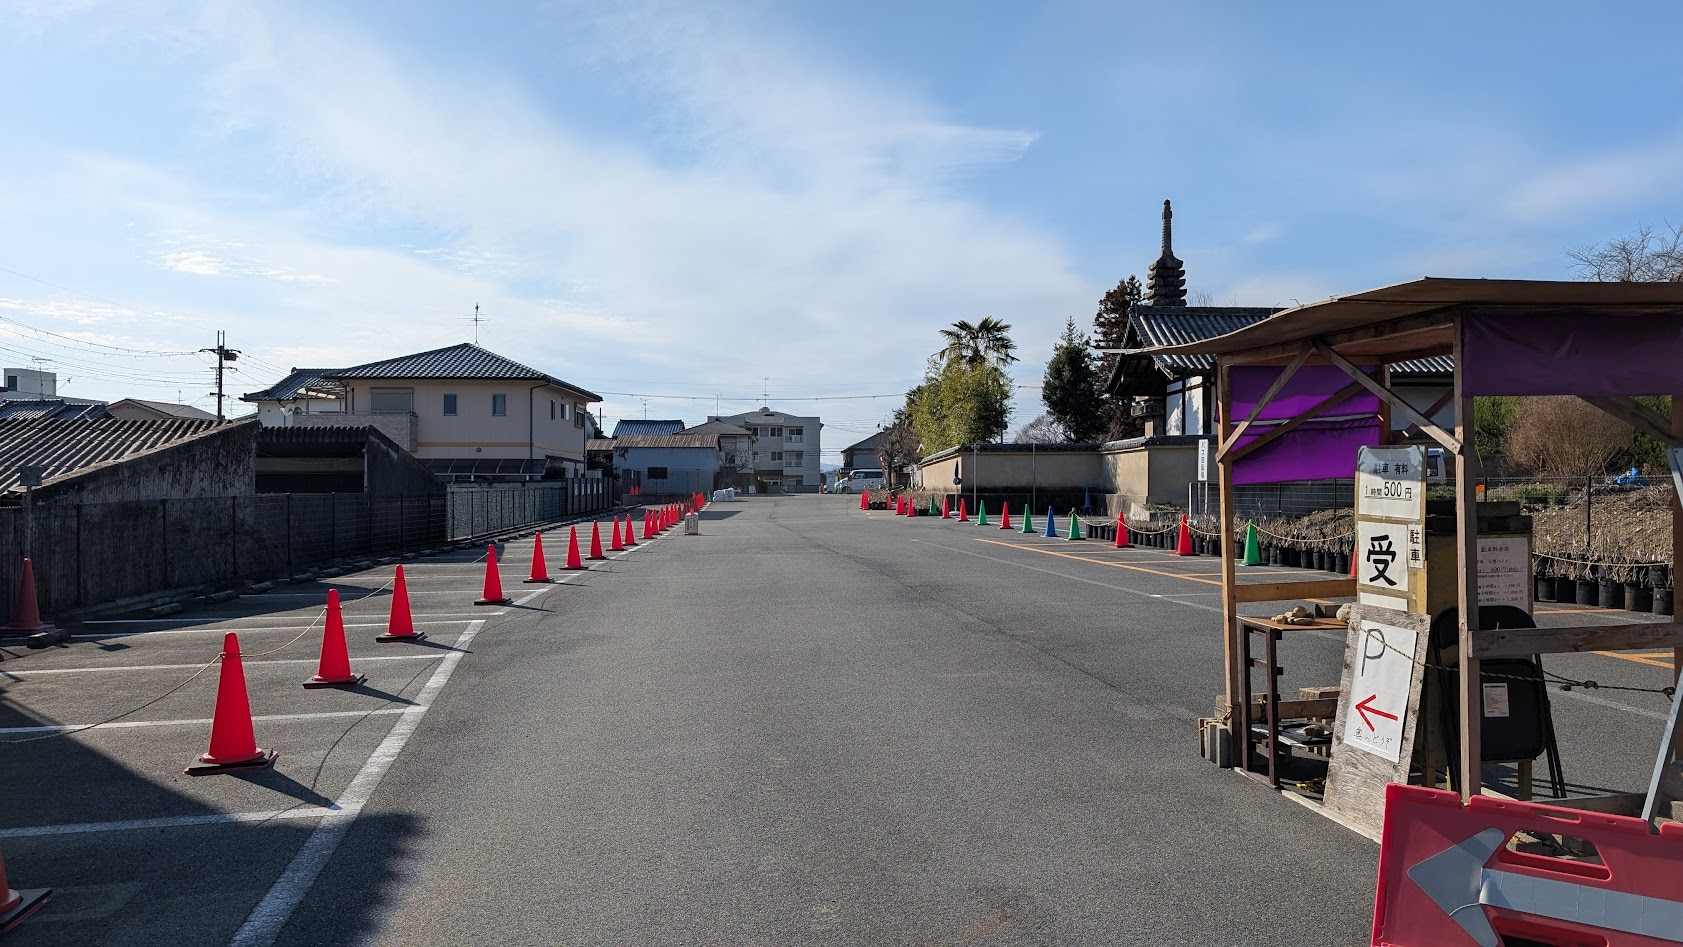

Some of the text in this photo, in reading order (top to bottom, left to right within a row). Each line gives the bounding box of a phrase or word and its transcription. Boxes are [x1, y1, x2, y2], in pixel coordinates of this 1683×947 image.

[1373, 462, 1408, 475] 駐車 有料
[1366, 534, 1397, 586] 受
[1409, 529, 1421, 563] 駐車
[1361, 628, 1386, 677] P
[1353, 727, 1392, 749] 奥へどうぞ
